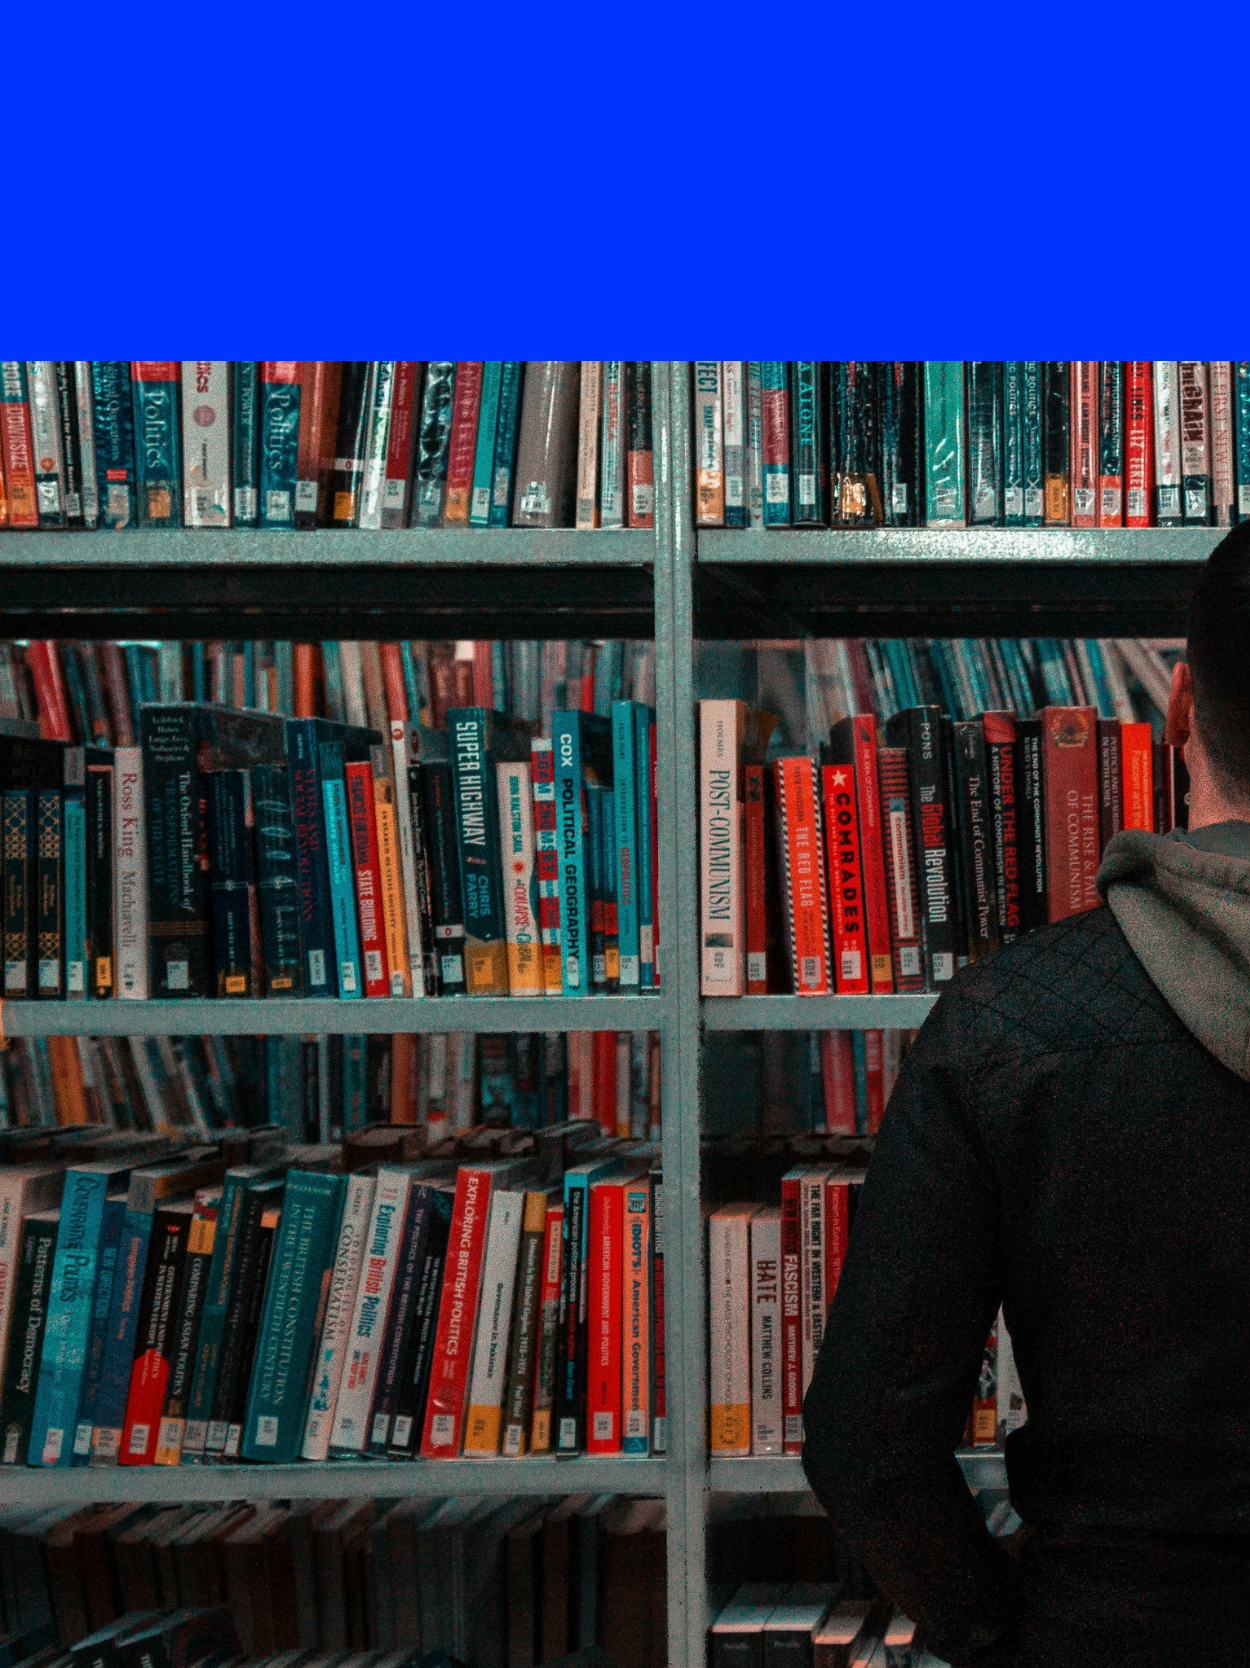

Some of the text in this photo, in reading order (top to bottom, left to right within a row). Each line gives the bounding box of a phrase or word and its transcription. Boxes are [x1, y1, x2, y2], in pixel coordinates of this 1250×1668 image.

[145, 390, 166, 469] Politics
[269, 393, 290, 469] Politics
[799, 381, 814, 447] ALONE
[455, 722, 485, 846] SUPER HIGHWAY
[537, 751, 555, 873] NOAM CHOMSKY
[921, 723, 948, 923] PONS The Global Revolution
[992, 757, 1001, 796] HISTORY
[994, 799, 1002, 811] OF
[120, 773, 138, 947] Ross King Machiavelli
[179, 771, 195, 912] The Oxford Handbook of
[561, 733, 579, 959] COX POLITICAL GEOGRAPHY
[620, 847, 631, 905] GEOPOLITICS
[708, 770, 731, 920] POST-COMMUNISM
[795, 827, 809, 847] THE
[798, 853, 811, 873] RED
[836, 792, 859, 933] COMRADES
[969, 776, 990, 938] The End of Communist Power
[994, 814, 1004, 872] COMMUNISM
[997, 875, 1005, 884] IN
[1000, 746, 1019, 926] UNDER THE RED FLAG
[1067, 791, 1081, 909] OF COMMUNISM
[1082, 794, 1097, 905] THE RISE & FALL
[358, 870, 377, 941] STATE BUILDING
[466, 874, 478, 918] PARRY
[479, 876, 491, 916] CHRIS
[799, 880, 814, 907] FLAG
[997, 888, 1007, 926] BRITAIN
[17, 1236, 51, 1393] Patterns of Democracy
[324, 1224, 354, 1340] CONSERVATISM
[358, 1205, 395, 1337] Exploring British Politics
[446, 1177, 479, 1355] EXPLORING BRITISH POLITICS
[784, 1254, 798, 1316] FASCISM
[173, 1257, 201, 1395] COMPARING ASIAN POLITICS
[632, 1280, 642, 1411] American Governmen
[757, 1260, 776, 1400] HATE MATTHEW COLLINS
[788, 1325, 796, 1361] MATTHEW
